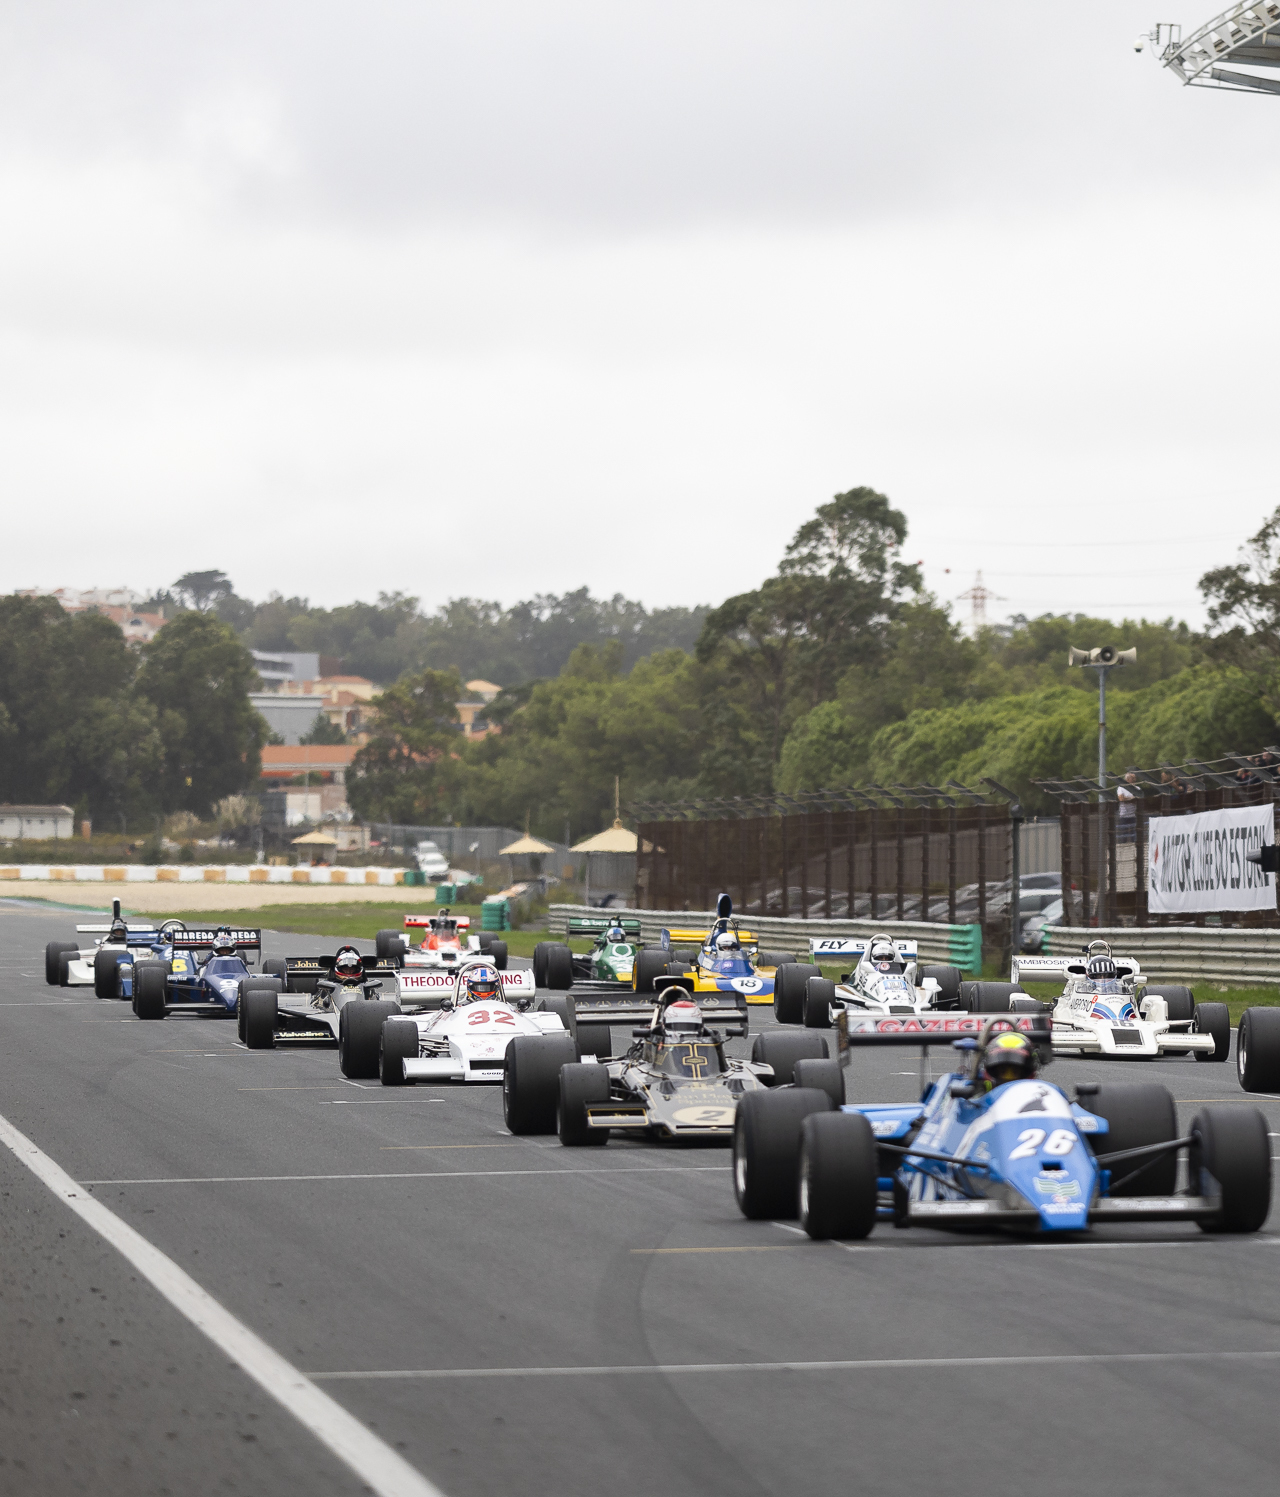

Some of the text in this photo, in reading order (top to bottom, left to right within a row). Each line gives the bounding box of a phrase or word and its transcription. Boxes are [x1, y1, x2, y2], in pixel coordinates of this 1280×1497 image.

[1161, 833, 1191, 892] MOTOR
[1215, 828, 1228, 889] DO
[819, 940, 848, 950] FLY
[295, 960, 319, 968] John
[738, 979, 757, 987] 18
[468, 1009, 516, 1026] 32
[694, 1110, 727, 1122] 2
[1009, 1128, 1078, 1160] 26
